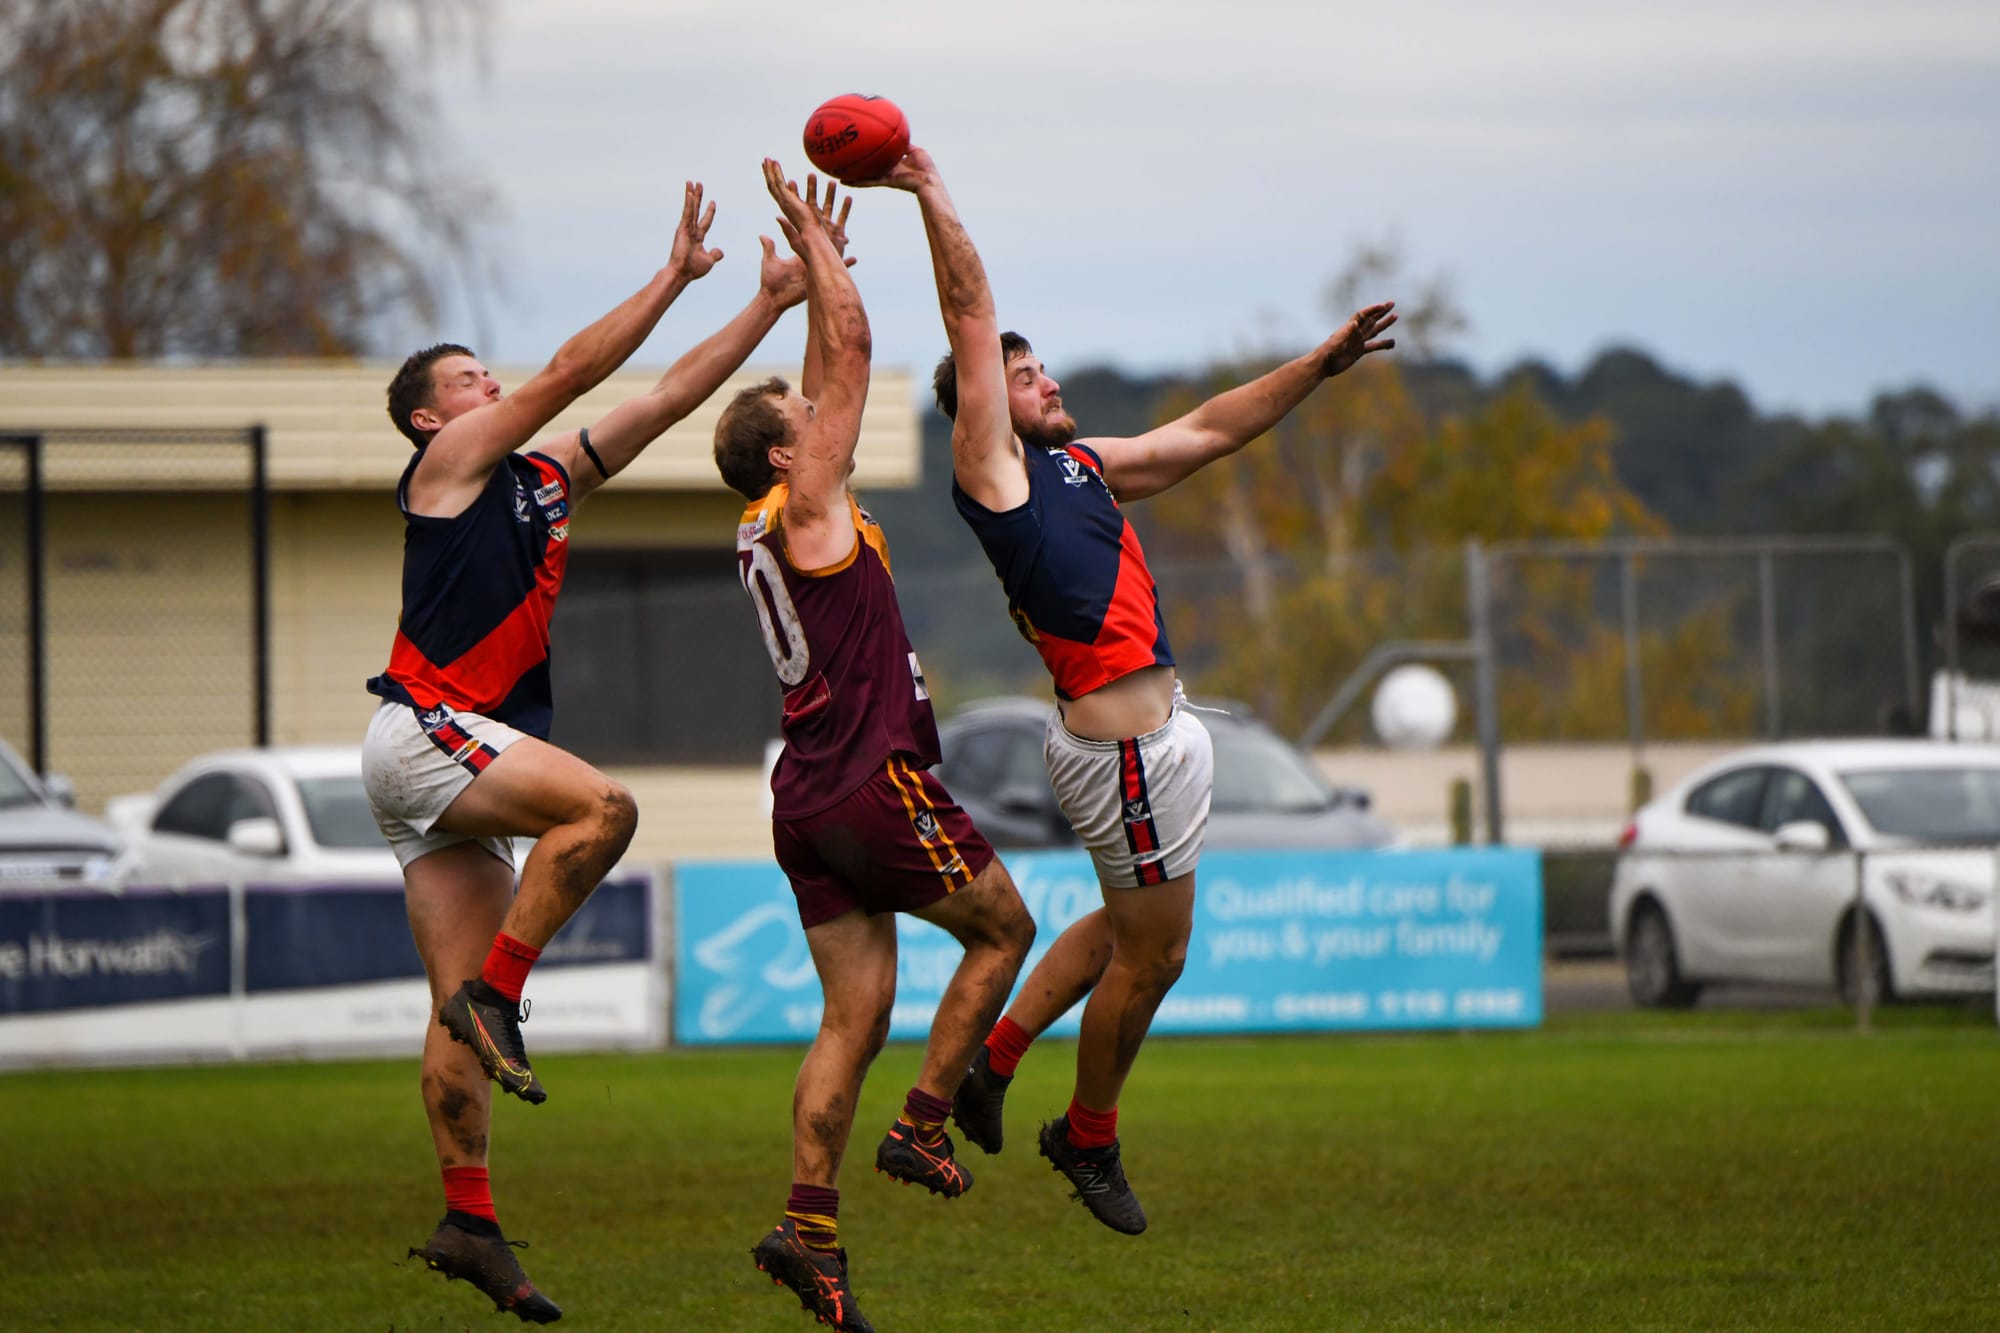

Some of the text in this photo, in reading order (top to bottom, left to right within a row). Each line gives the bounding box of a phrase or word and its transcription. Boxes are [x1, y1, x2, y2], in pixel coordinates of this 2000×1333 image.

[1206, 874, 1495, 919] Qualified care for
[1208, 918, 1501, 967] you & your family
